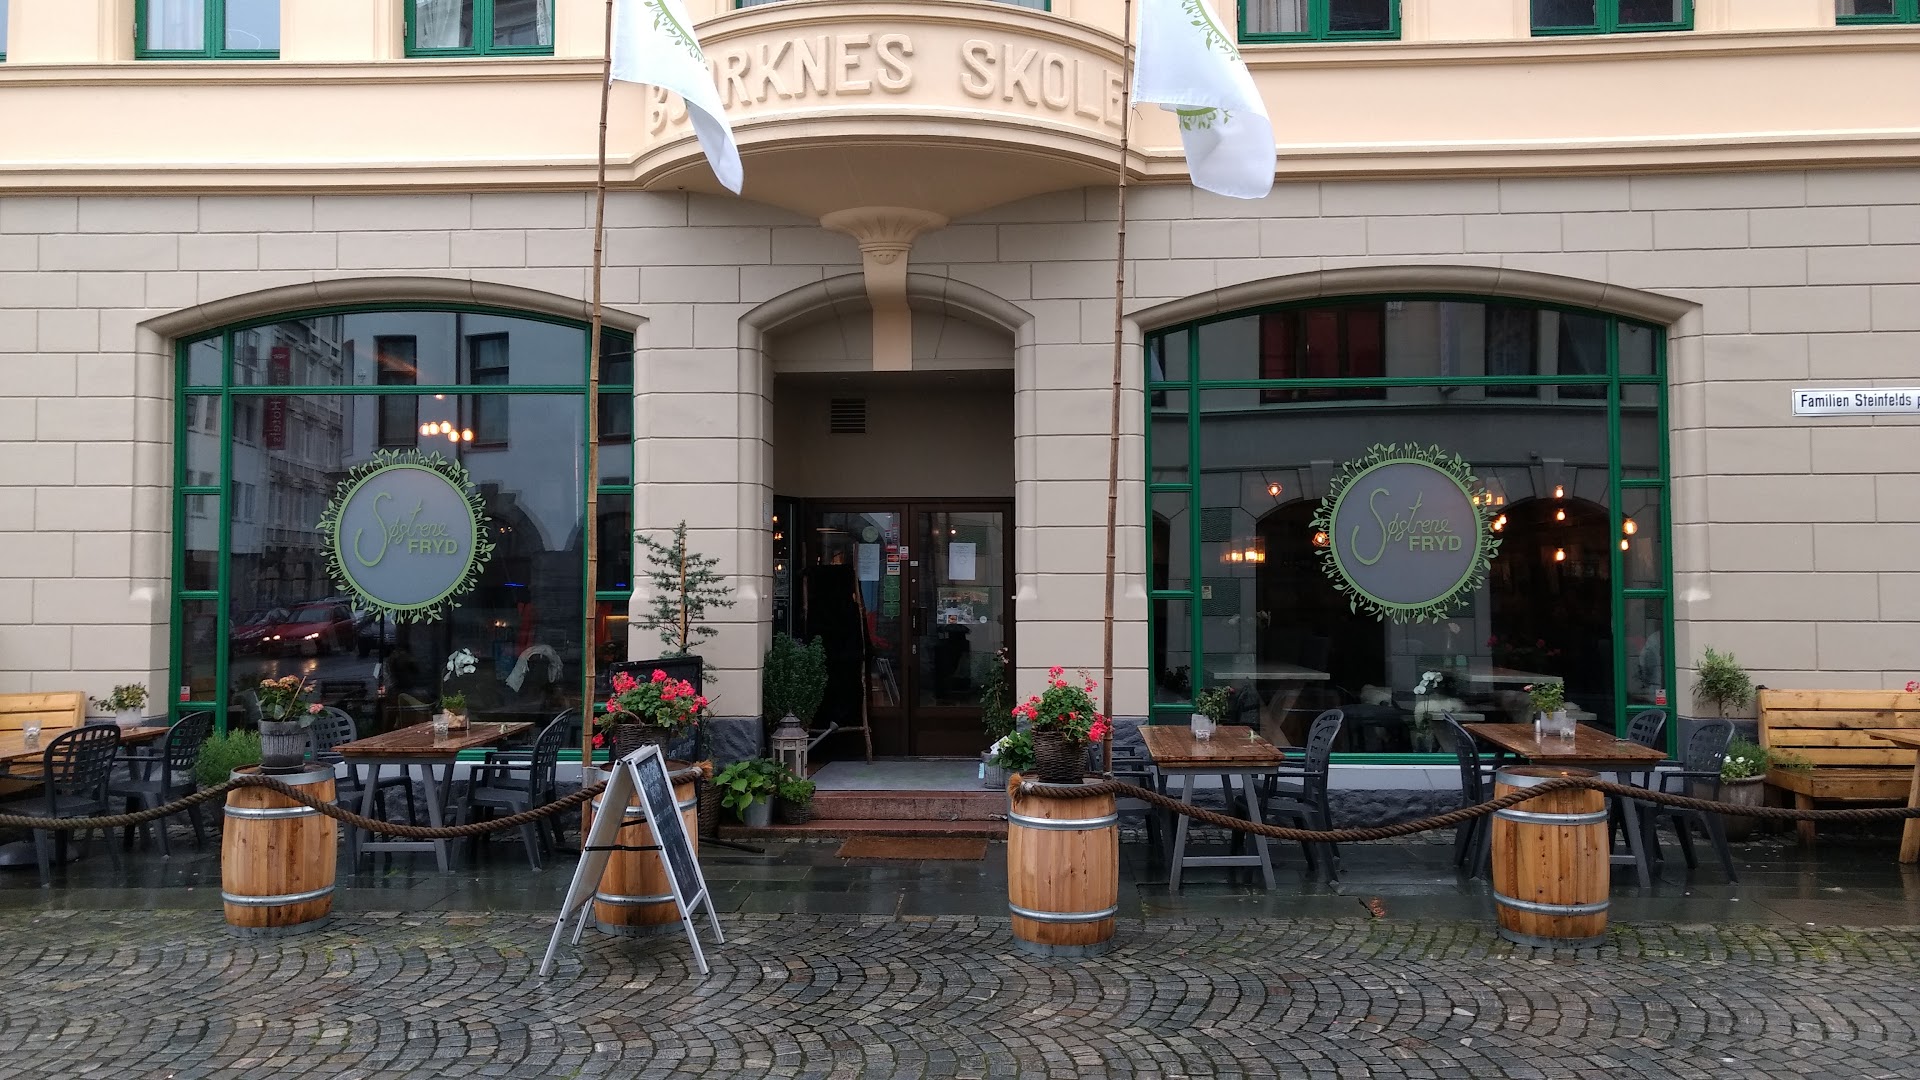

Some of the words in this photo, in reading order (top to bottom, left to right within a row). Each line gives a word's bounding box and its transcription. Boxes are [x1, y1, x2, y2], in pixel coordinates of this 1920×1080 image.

[649, 33, 914, 136] BJRKNES
[961, 38, 1124, 129] SKOLE
[1800, 394, 1849, 408] Familien
[1855, 393, 1912, 407] Steinfelds
[407, 539, 459, 555] FRYD
[1408, 535, 1462, 552] FRYD
